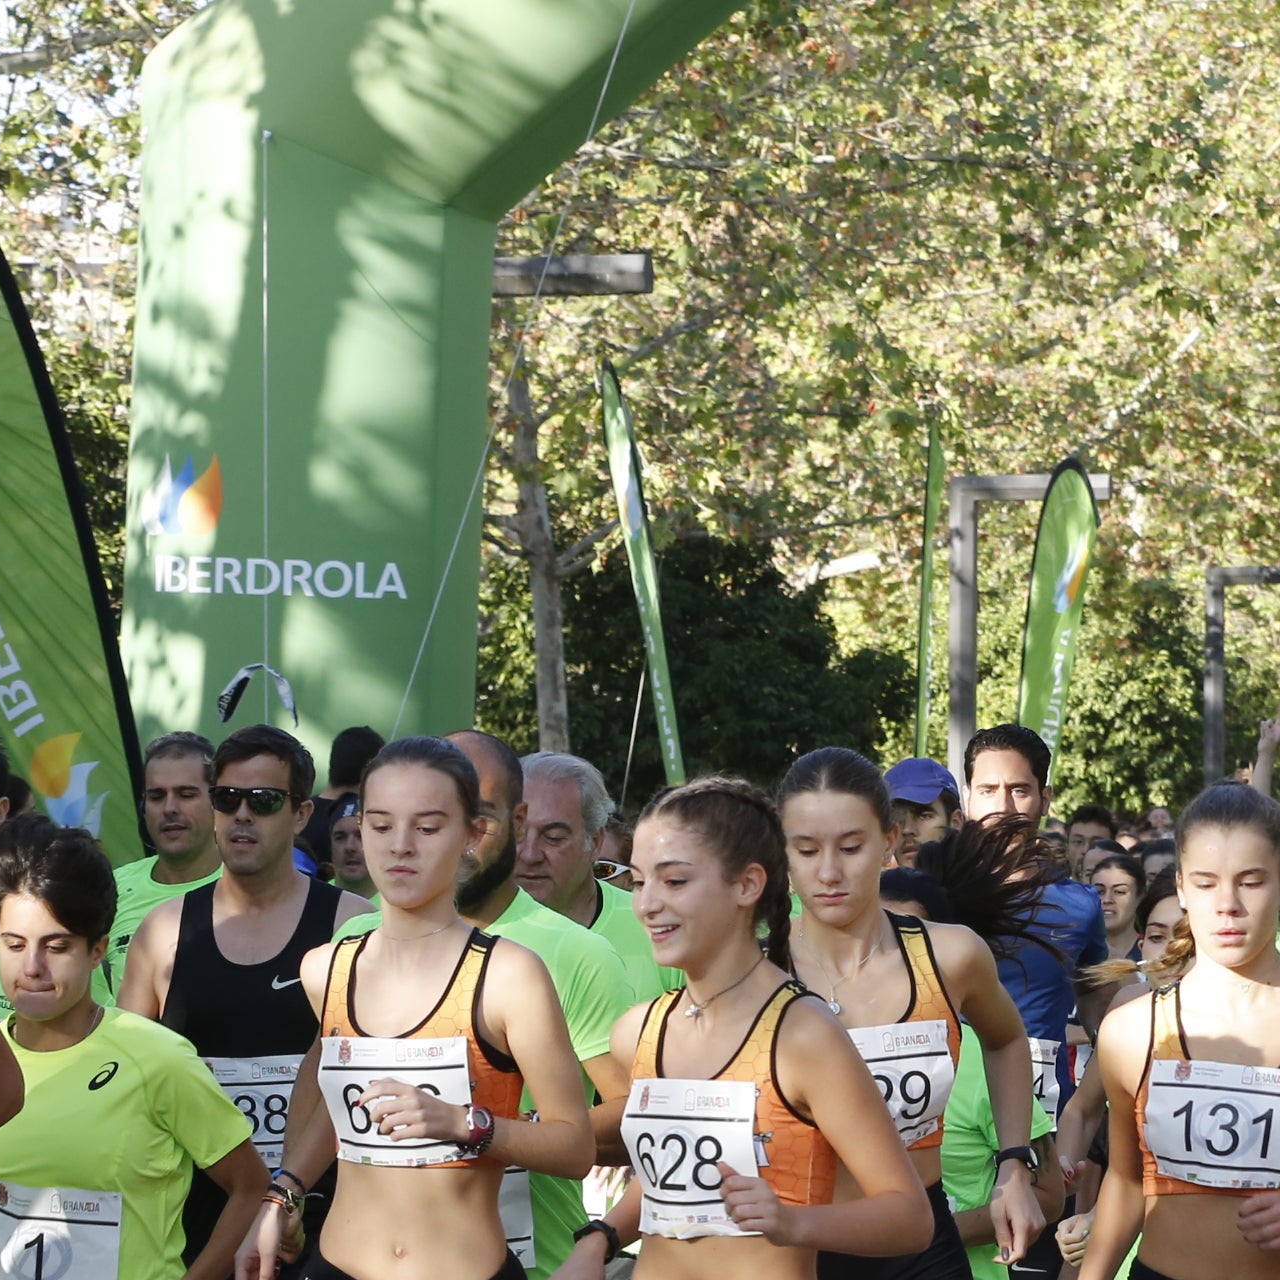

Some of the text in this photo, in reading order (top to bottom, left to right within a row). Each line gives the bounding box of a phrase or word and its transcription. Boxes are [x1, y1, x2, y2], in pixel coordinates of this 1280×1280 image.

[154, 554, 407, 600] IBERDROLA
[1173, 1100, 1274, 1159] 131
[636, 1132, 724, 1191] 628
[62, 1200, 100, 1212] GRANADA
